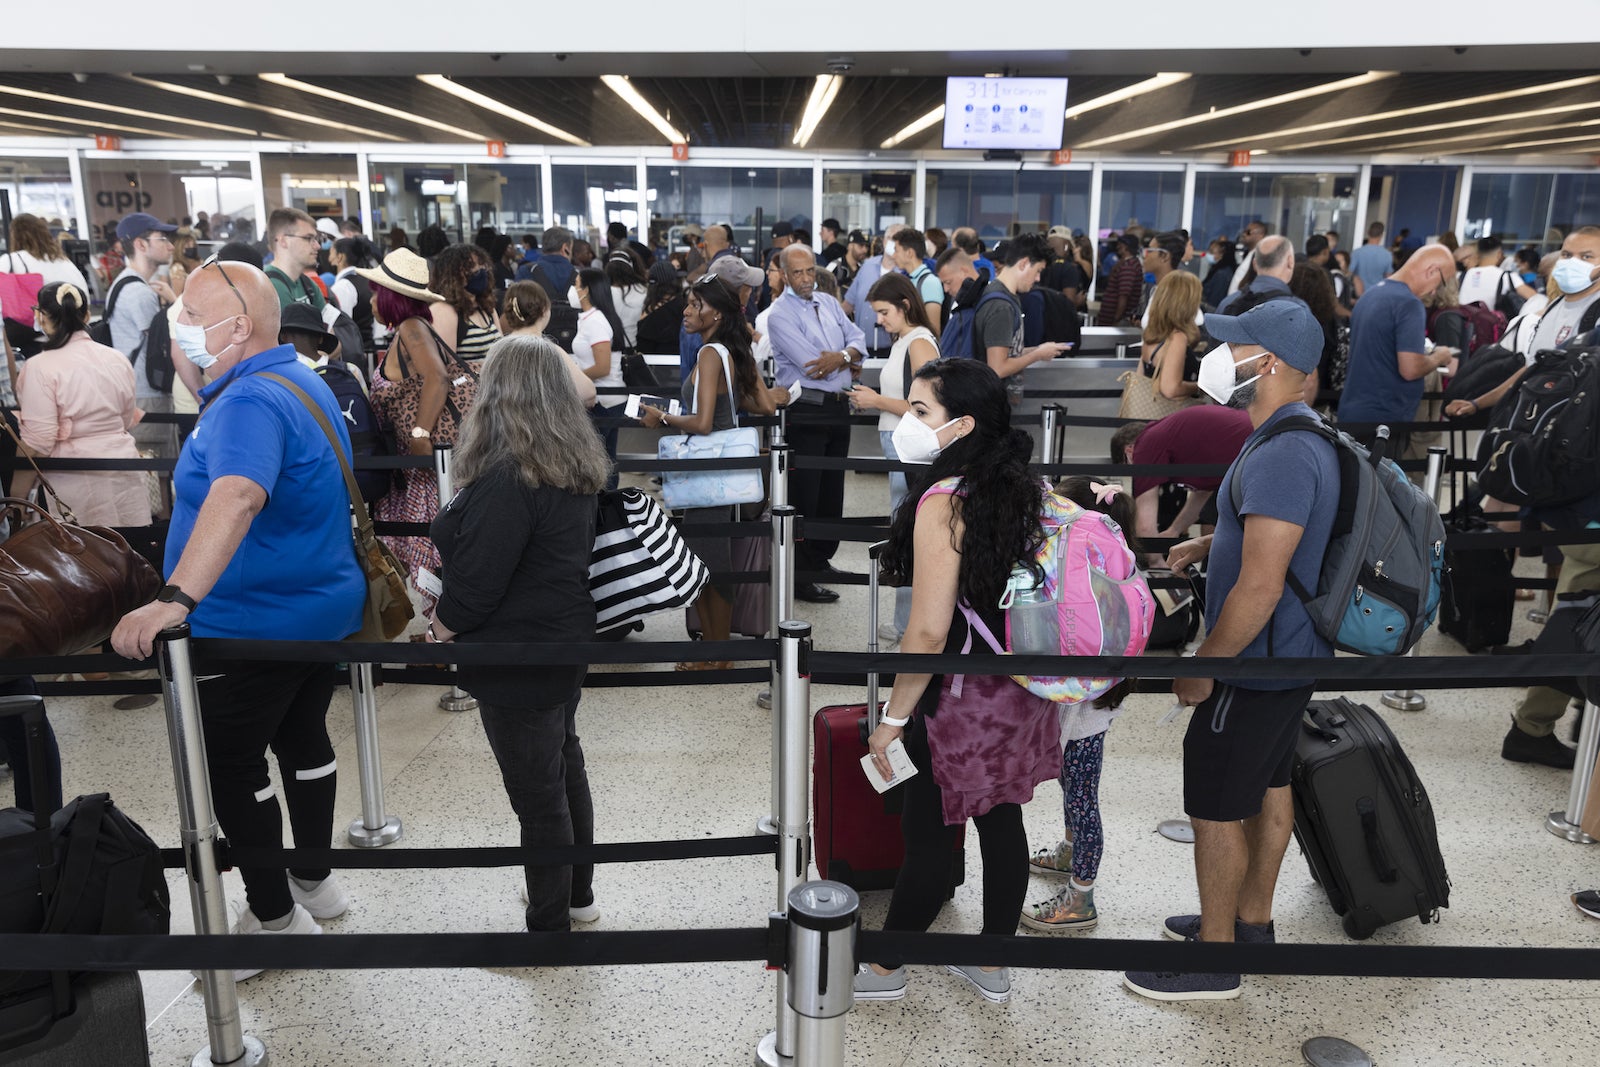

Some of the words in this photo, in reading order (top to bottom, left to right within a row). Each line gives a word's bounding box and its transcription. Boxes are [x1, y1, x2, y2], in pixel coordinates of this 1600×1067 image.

[491, 143, 499, 156] 8
[676, 145, 684, 158] 9
[1058, 150, 1070, 163] 10
[1238, 153, 1248, 164] 11
[96, 190, 152, 214] app
